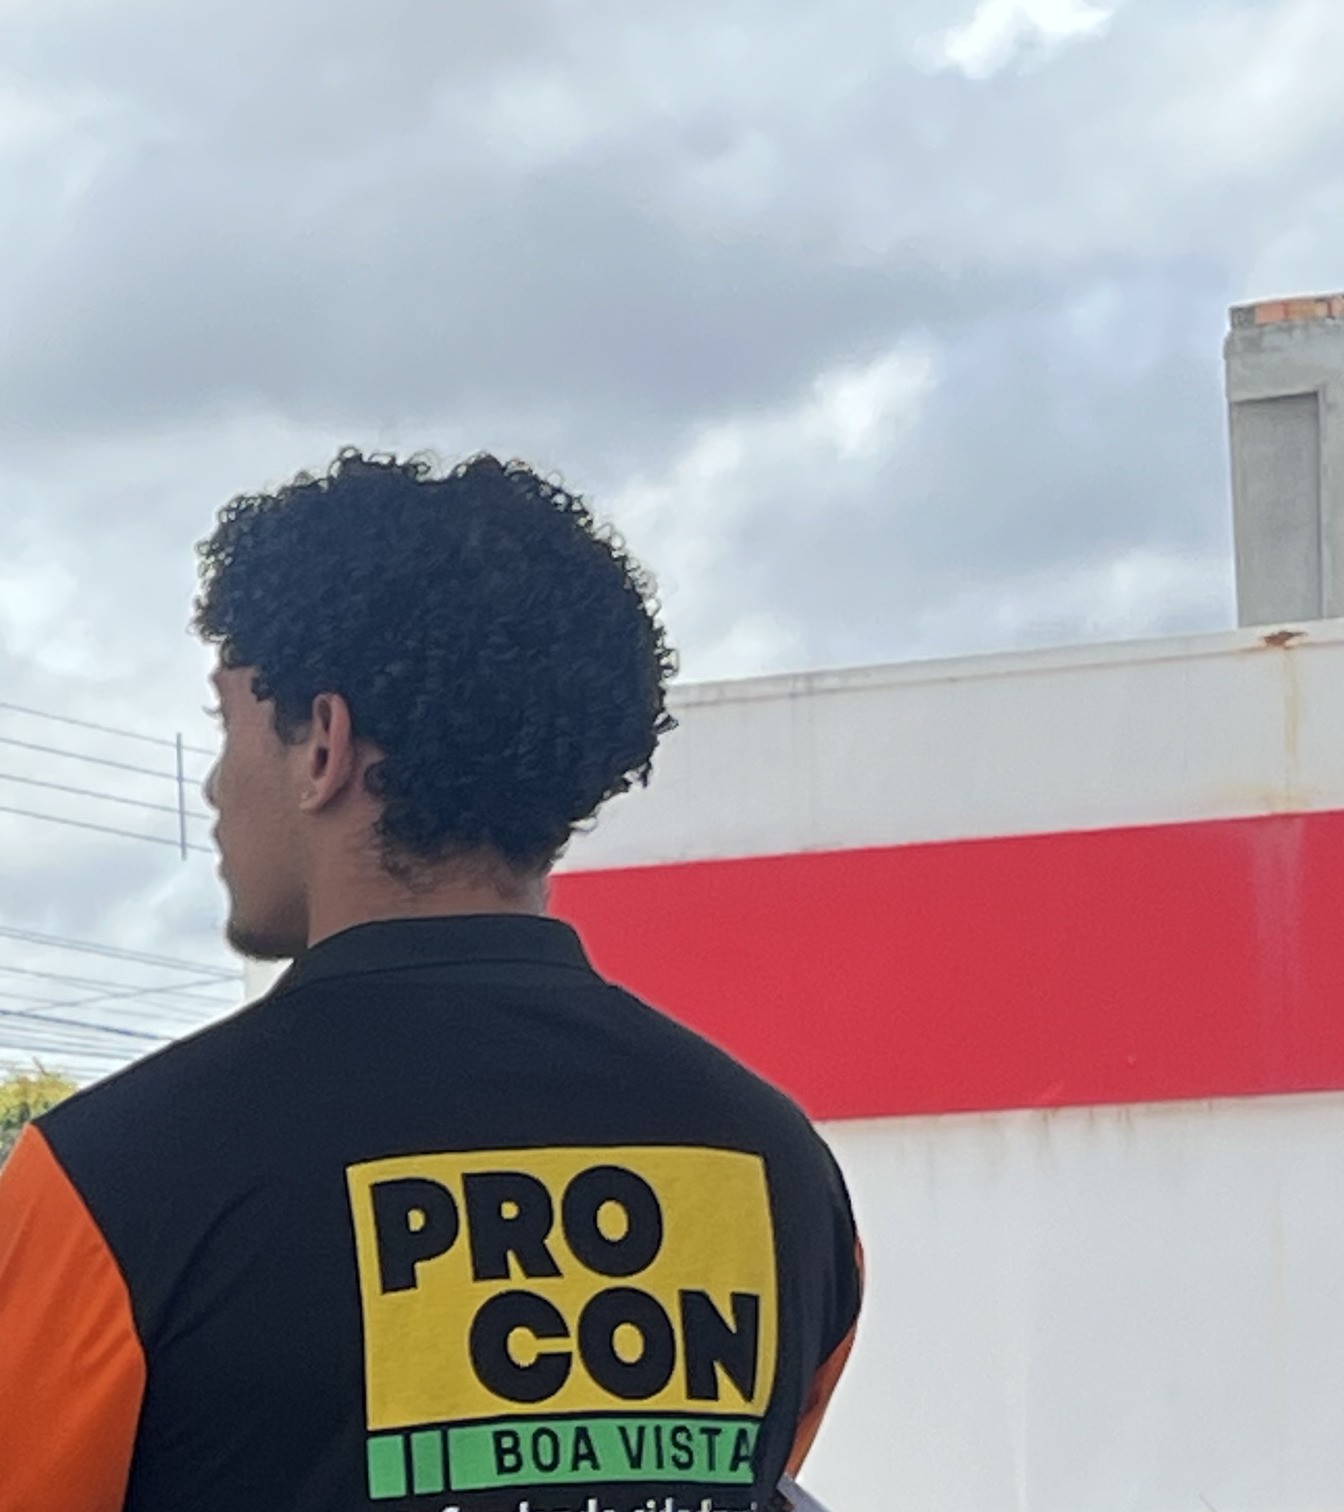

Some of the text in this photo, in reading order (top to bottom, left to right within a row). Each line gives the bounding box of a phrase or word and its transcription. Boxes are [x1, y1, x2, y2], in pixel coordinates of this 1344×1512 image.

[371, 1165, 663, 1295] PRO
[469, 1286, 760, 1403] CON
[492, 1425, 759, 1475] BOA VISTA
